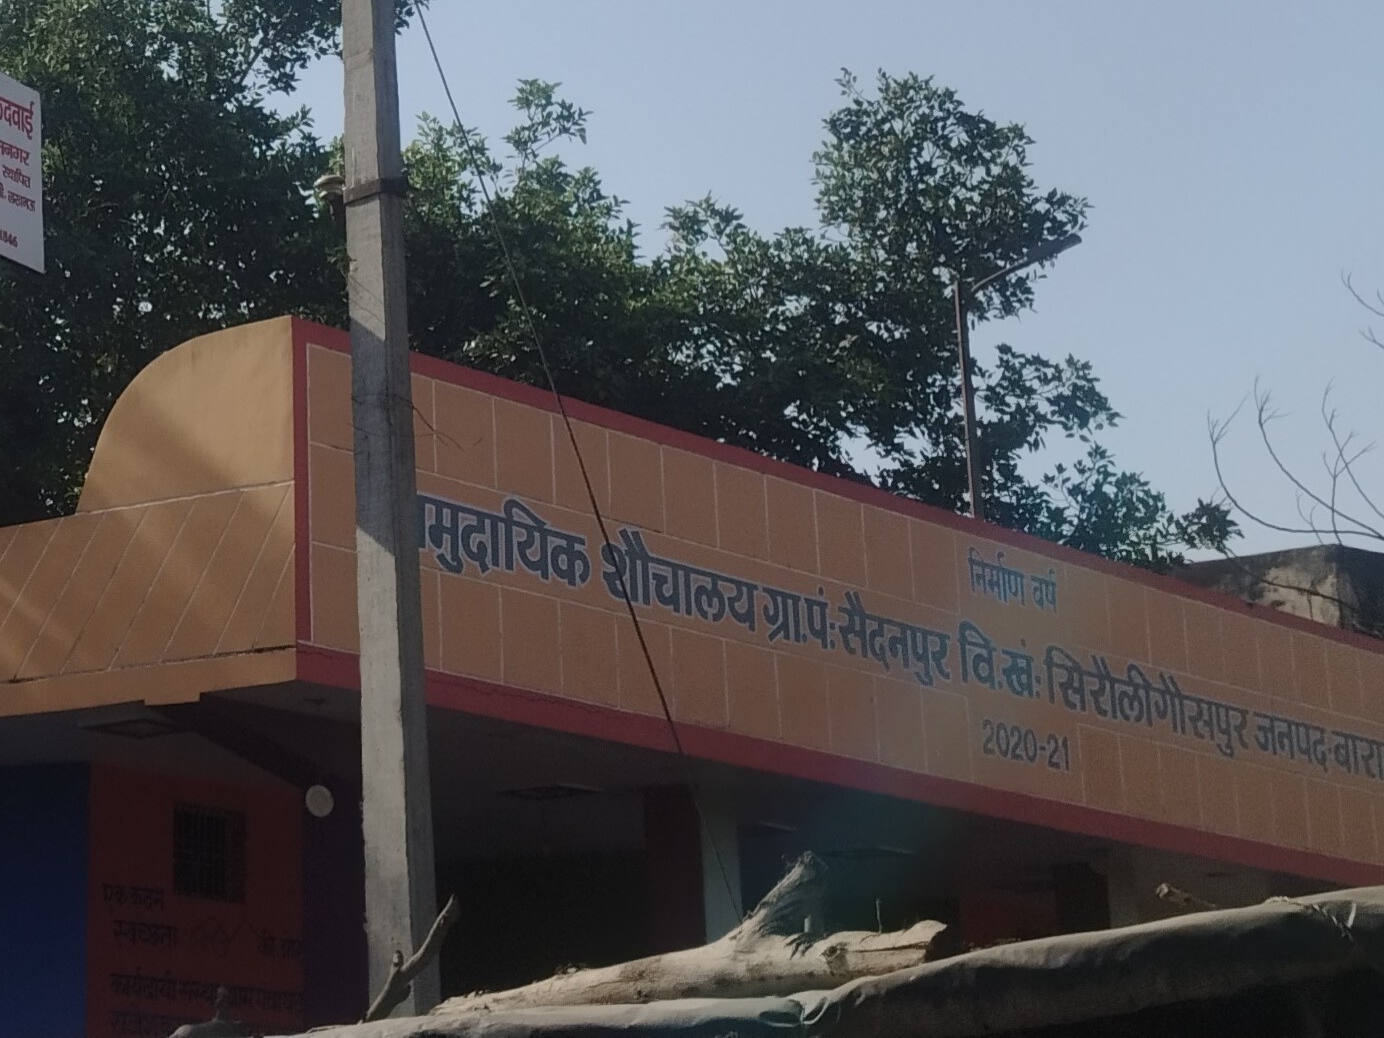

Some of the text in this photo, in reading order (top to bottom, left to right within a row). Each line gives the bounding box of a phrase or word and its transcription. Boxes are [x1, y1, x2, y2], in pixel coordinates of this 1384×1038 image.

[2, 164, 31, 189] स्थापित
[968, 546, 1057, 613] निर्माण वर्ष
[600, 528, 758, 632] शौचालय
[836, 589, 951, 687] सैदनपुर
[1331, 729, 1384, 781] बारा
[982, 719, 1070, 771] 2020-21
